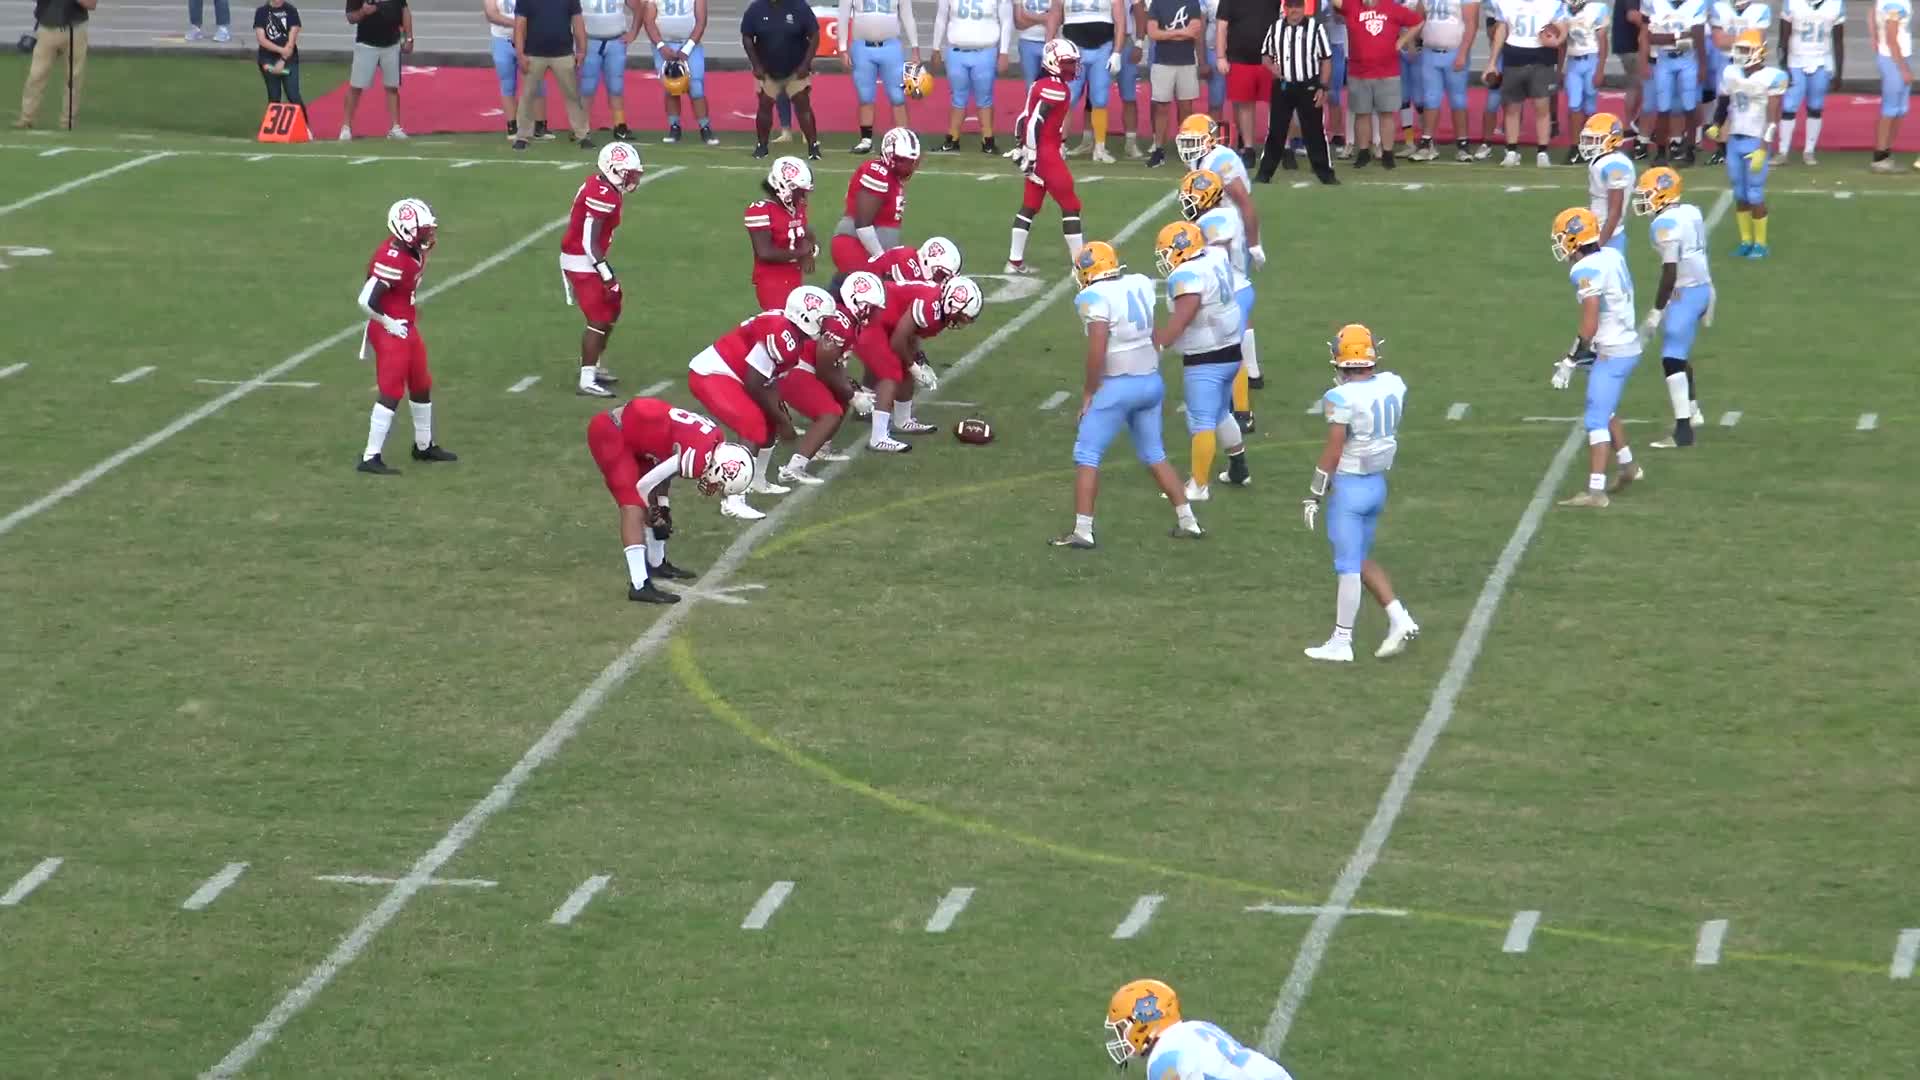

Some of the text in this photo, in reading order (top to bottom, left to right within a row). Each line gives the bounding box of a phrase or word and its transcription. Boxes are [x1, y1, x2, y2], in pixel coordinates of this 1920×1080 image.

[1165, 6, 1188, 31] A
[1514, 15, 1537, 38] 51
[263, 105, 297, 135] 30
[598, 185, 609, 195] 7
[1370, 393, 1402, 439] 10
